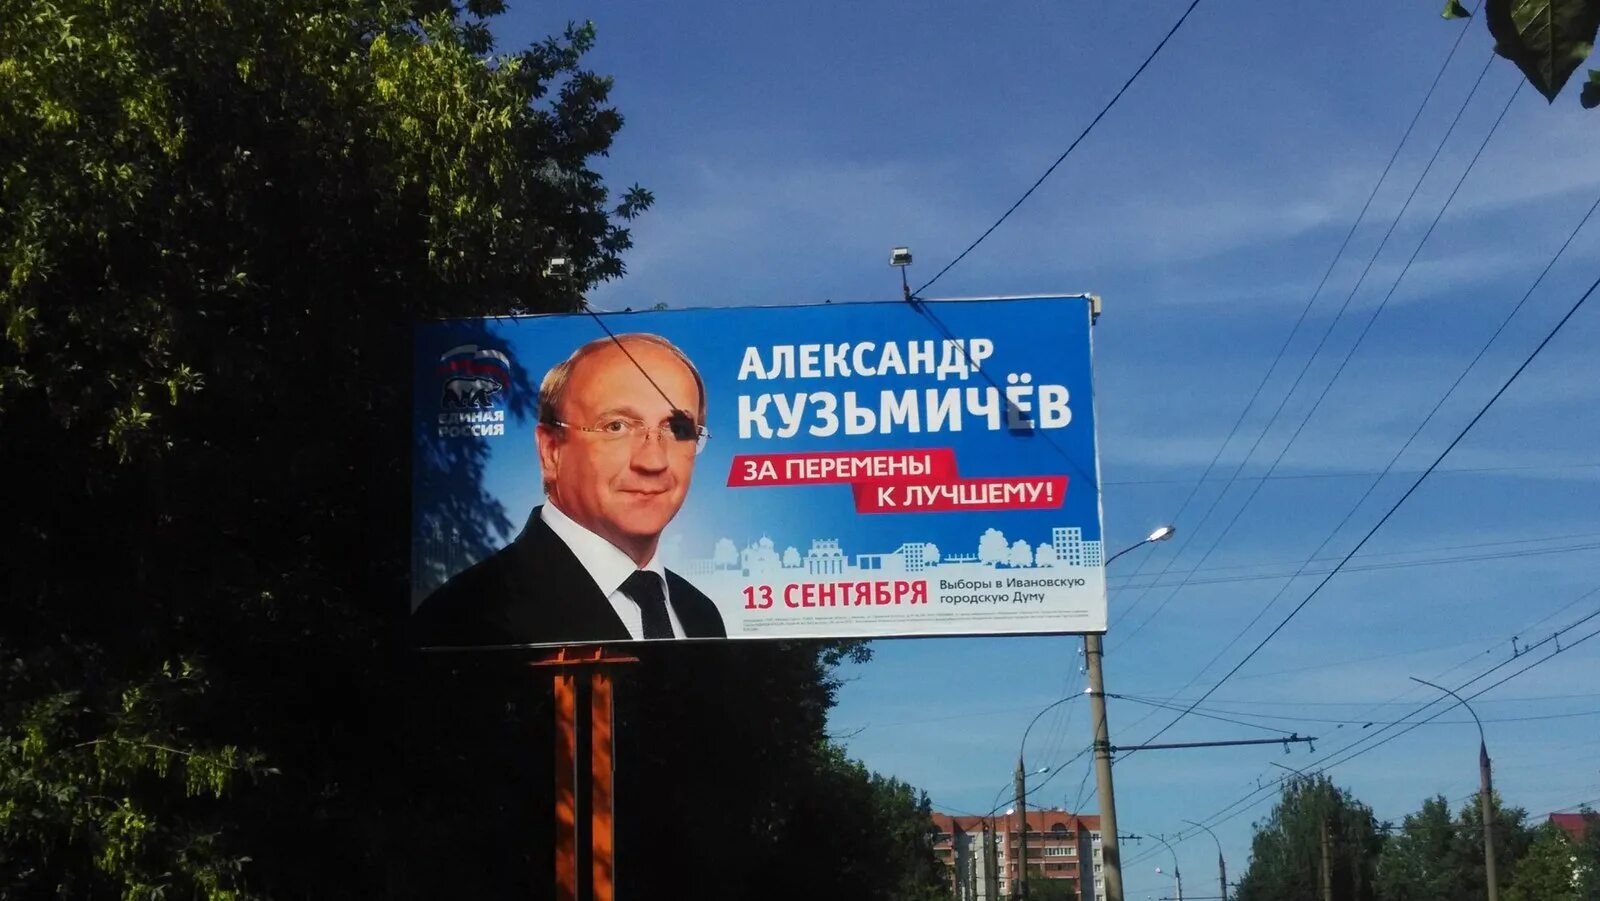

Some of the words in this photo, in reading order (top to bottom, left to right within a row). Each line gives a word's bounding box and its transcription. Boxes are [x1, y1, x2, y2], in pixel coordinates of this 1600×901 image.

[737, 338, 994, 381] АЛЕКСАНДР
[438, 410, 504, 424] ЕДИНАЯ
[738, 372, 1073, 439] КУЗЬМИЧЁВ
[438, 423, 504, 438] РОССИЯ
[743, 460, 778, 481] ЗА
[785, 455, 931, 479] ПЕРЕМЕНЫ
[877, 487, 896, 507] К
[903, 482, 1053, 506] ЛУЧШЕМУ!
[743, 585, 773, 610] 13
[784, 580, 928, 608] СЕНТЯБРЯ
[939, 579, 992, 591] Выборы
[996, 580, 1003, 588] в
[1006, 577, 1085, 590] Ивановскую
[940, 593, 1009, 605] городскую
[1012, 591, 1045, 604] Думу
